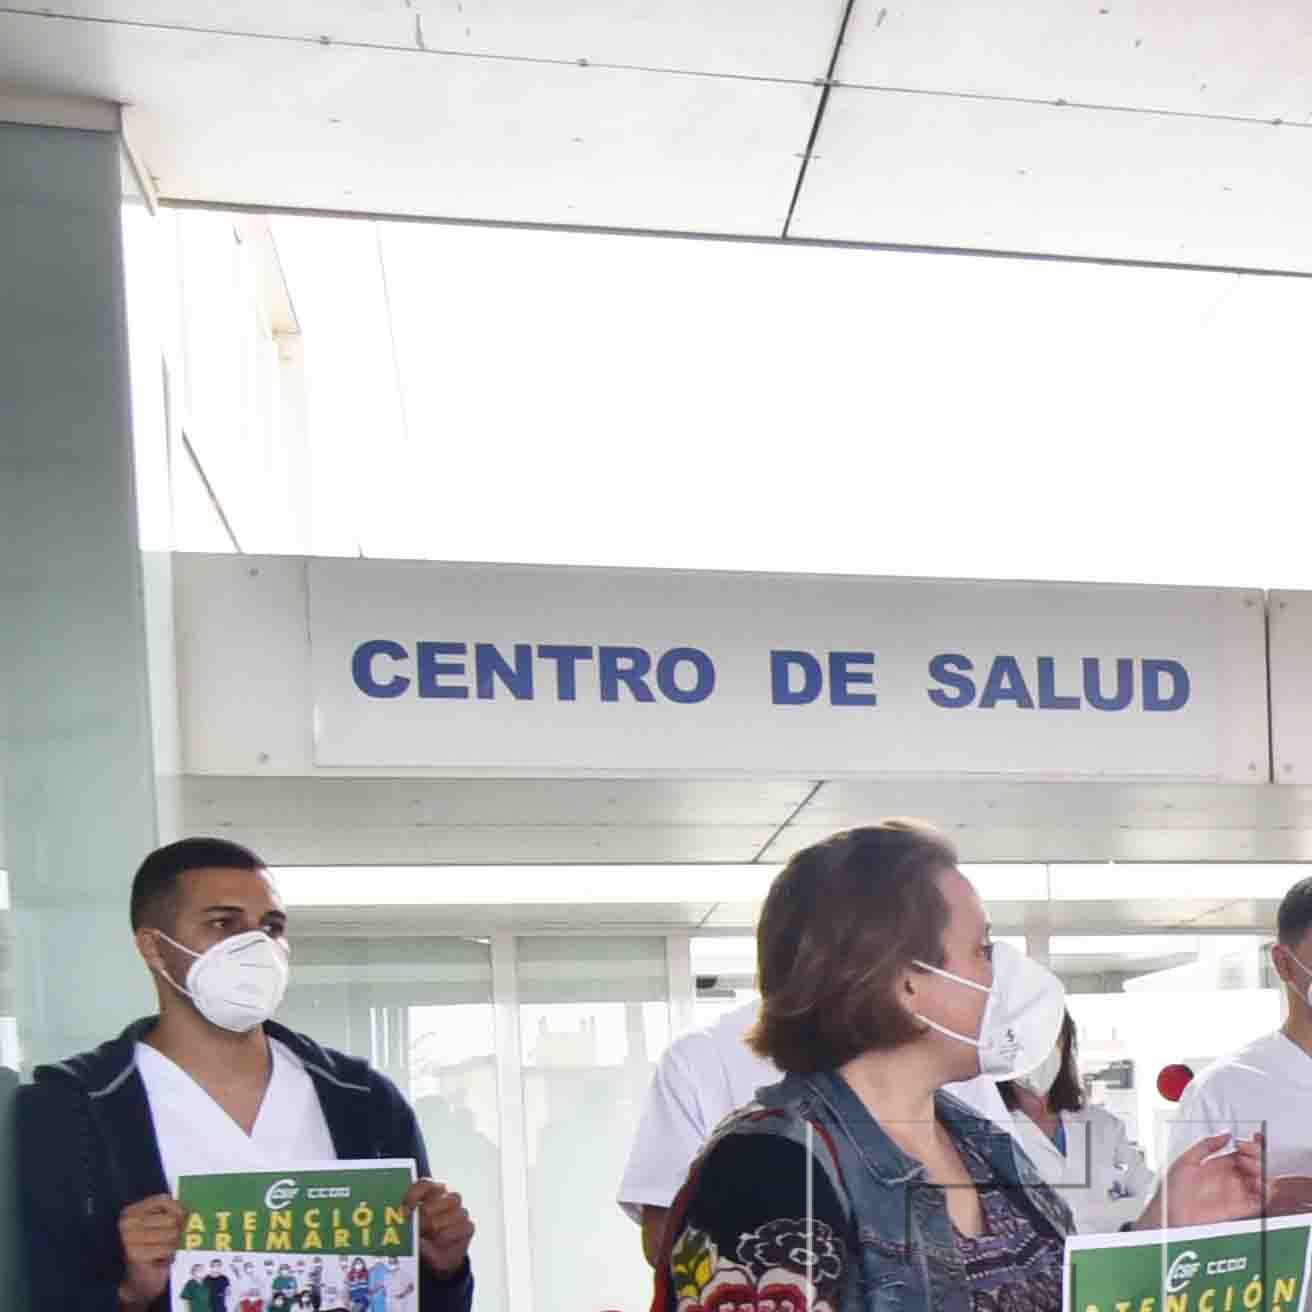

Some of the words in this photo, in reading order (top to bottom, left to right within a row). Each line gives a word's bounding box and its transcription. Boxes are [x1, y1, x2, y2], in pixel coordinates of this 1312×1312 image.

[351, 639, 717, 704] CENTRO
[769, 649, 877, 707] DE
[926, 654, 1191, 712] SALUD
[185, 1201, 405, 1232] ATENCIÓN
[185, 1228, 401, 1251] PRIMARIA
[1206, 1257, 1248, 1276] CCOO
